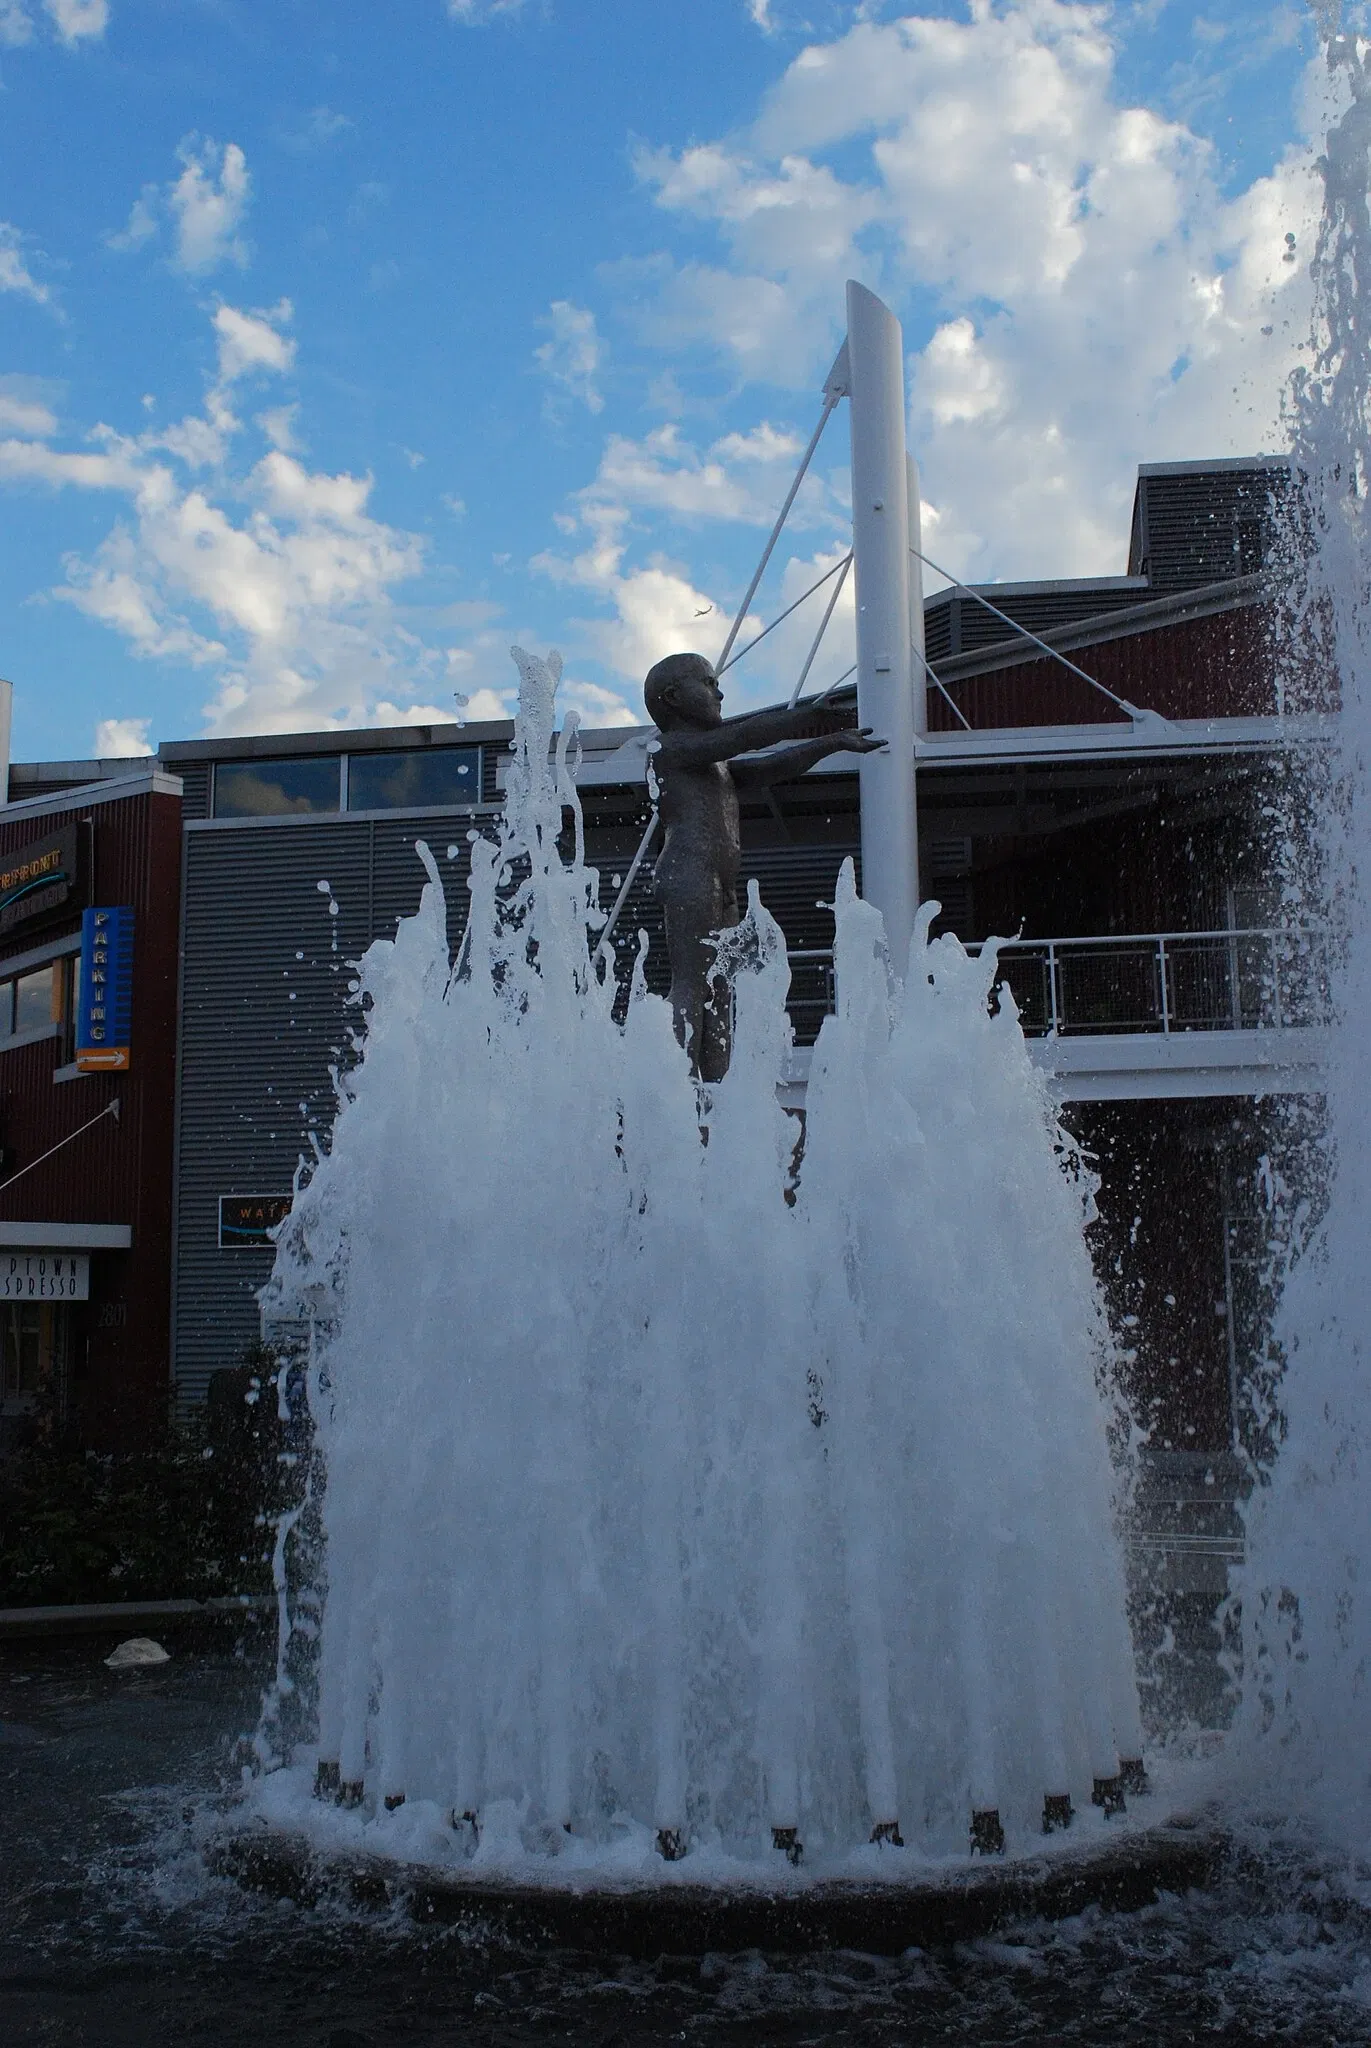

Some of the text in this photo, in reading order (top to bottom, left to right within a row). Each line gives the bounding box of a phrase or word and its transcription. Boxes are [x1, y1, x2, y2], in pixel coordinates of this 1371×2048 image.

[90, 912, 108, 1041] PARKING
[5, 1277, 76, 1296] SPRESSO
[96, 1303, 127, 1328] 2801
